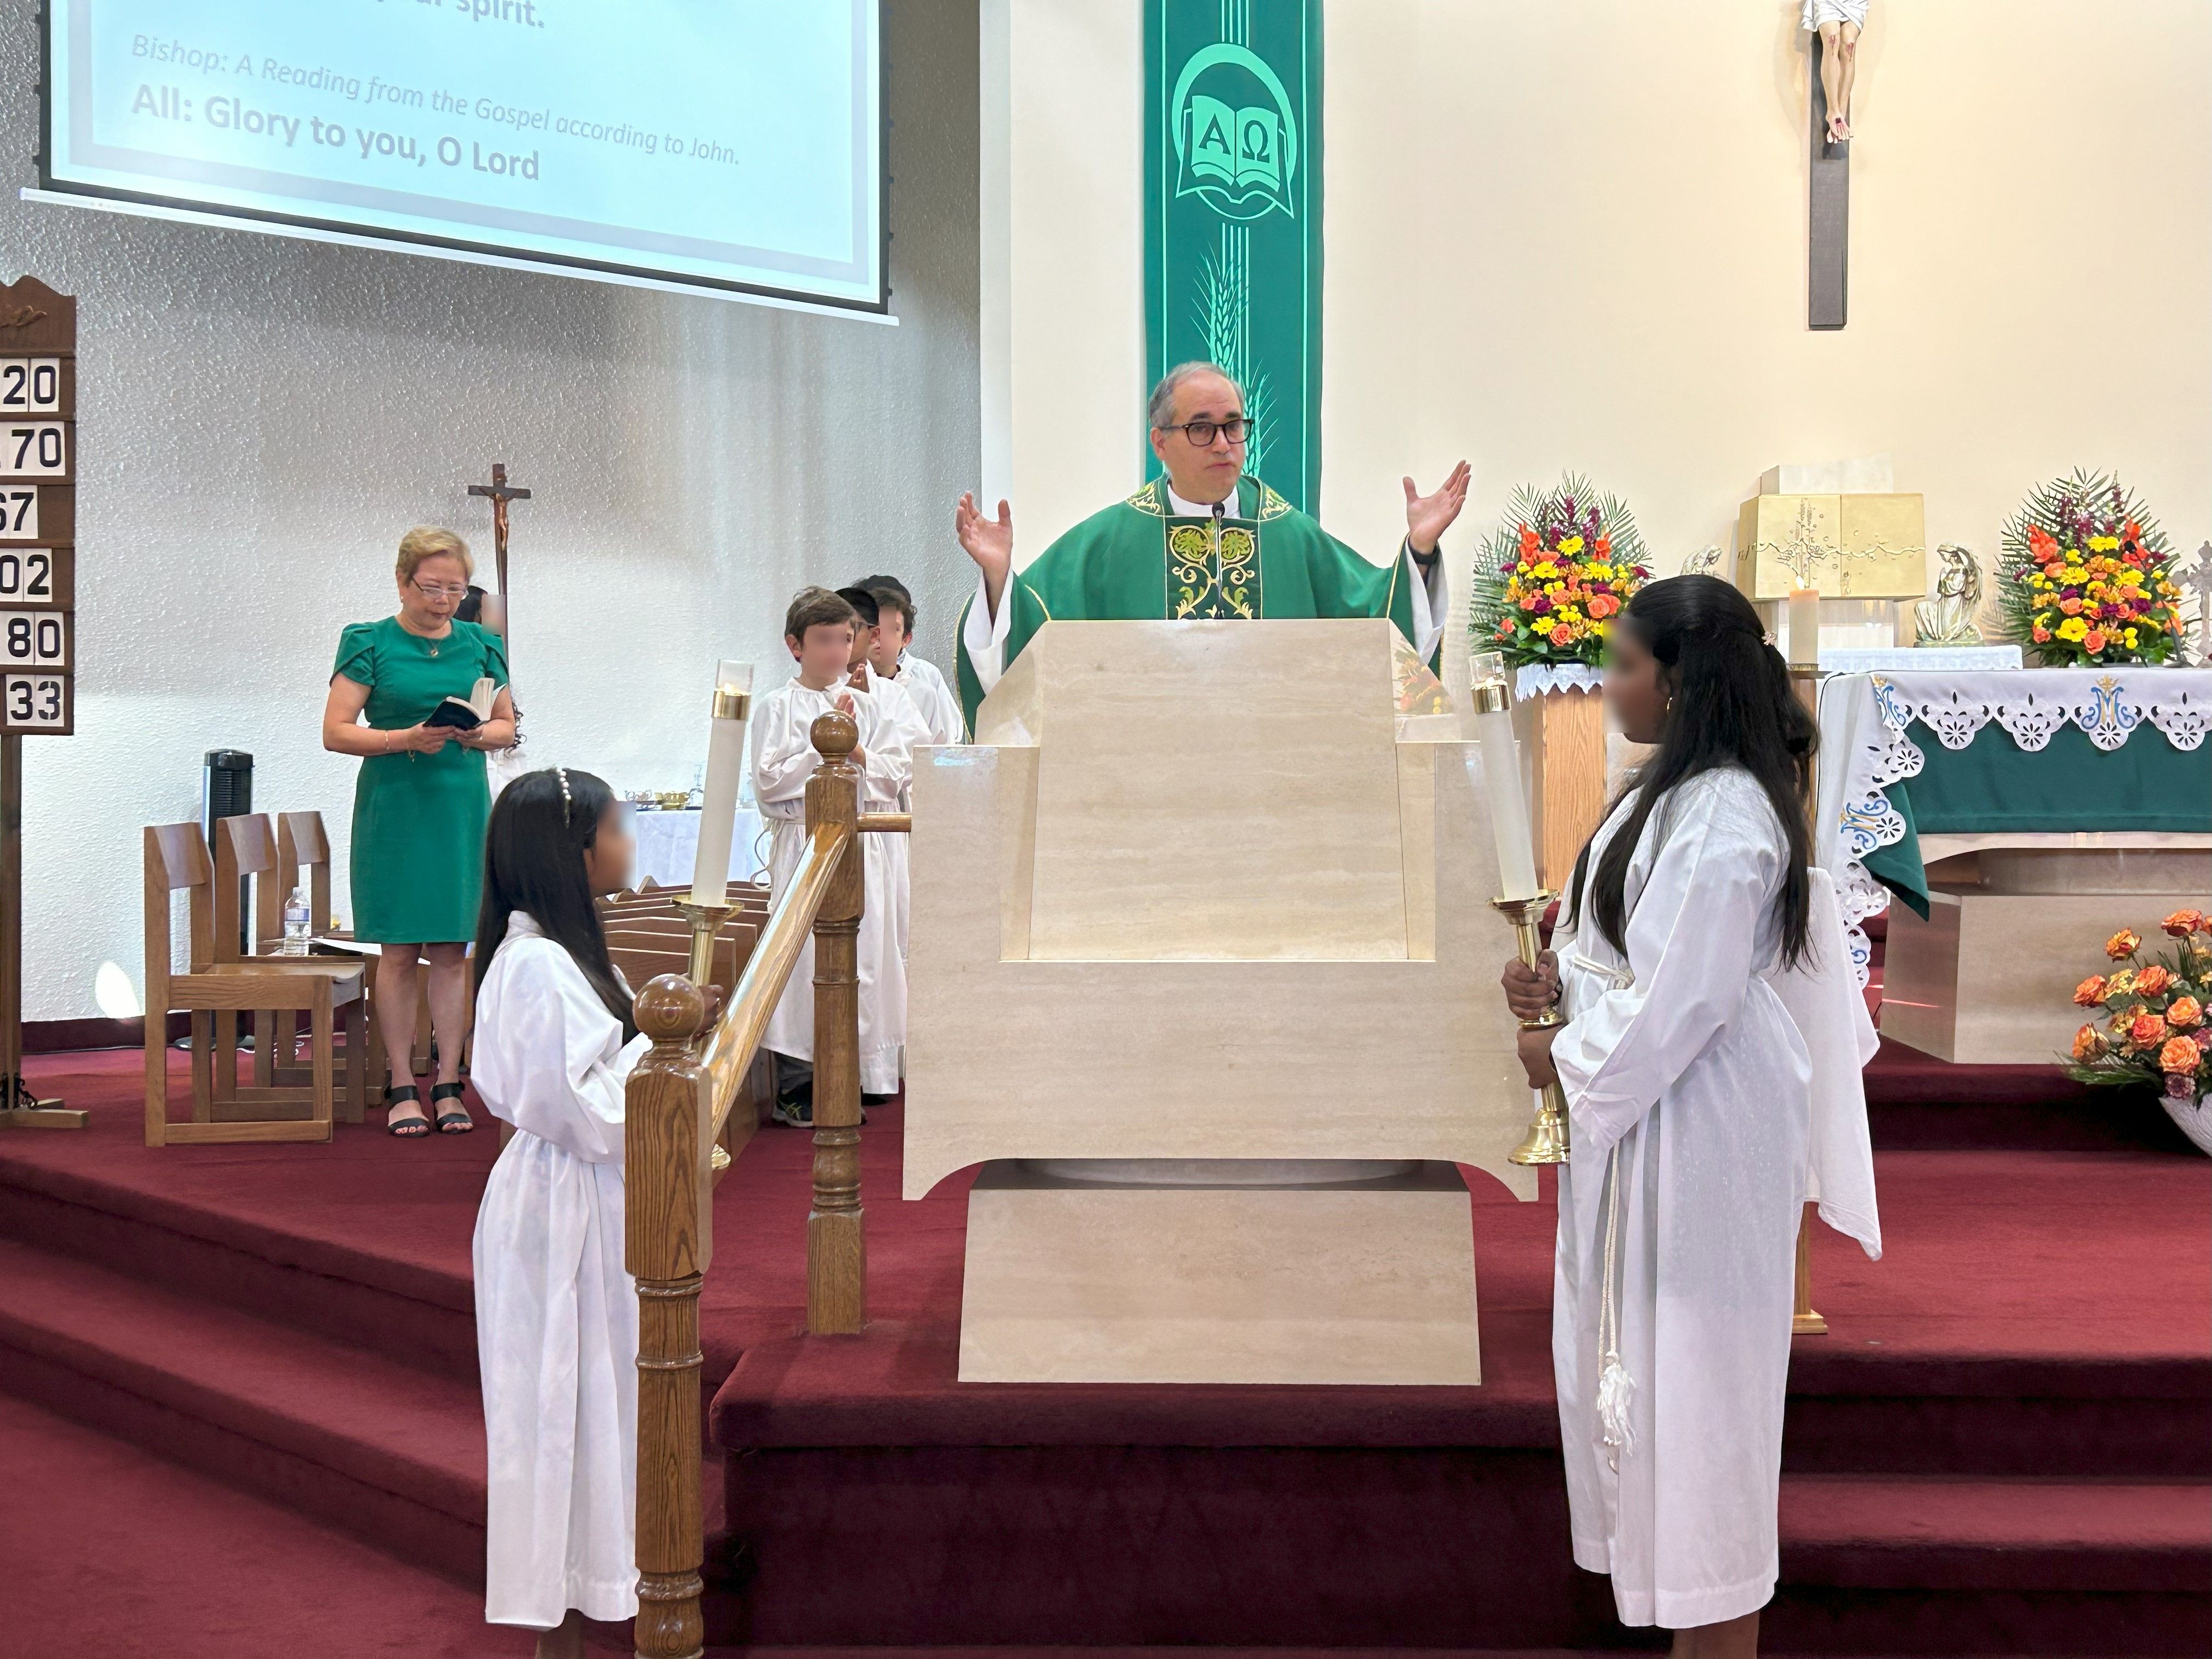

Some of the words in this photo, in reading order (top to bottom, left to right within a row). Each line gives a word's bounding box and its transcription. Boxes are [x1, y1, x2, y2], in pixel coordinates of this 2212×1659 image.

[132, 34, 229, 75] Bishop:
[234, 54, 253, 76] A
[261, 57, 360, 100] Reading
[364, 75, 424, 104] from
[431, 89, 468, 115] the
[475, 98, 549, 131] Gospel
[556, 116, 658, 155] according
[664, 133, 684, 154] to
[689, 137, 738, 165] John.
[132, 84, 192, 121] All:
[204, 95, 301, 147] Glory
[310, 116, 346, 147] to
[356, 128, 426, 167] you,
[437, 136, 461, 166] O
[473, 141, 539, 180] Lord
[3, 365, 55, 404] 20
[0, 554, 49, 595] 02
[8, 618, 60, 658] 80
[9, 680, 61, 720] 33
